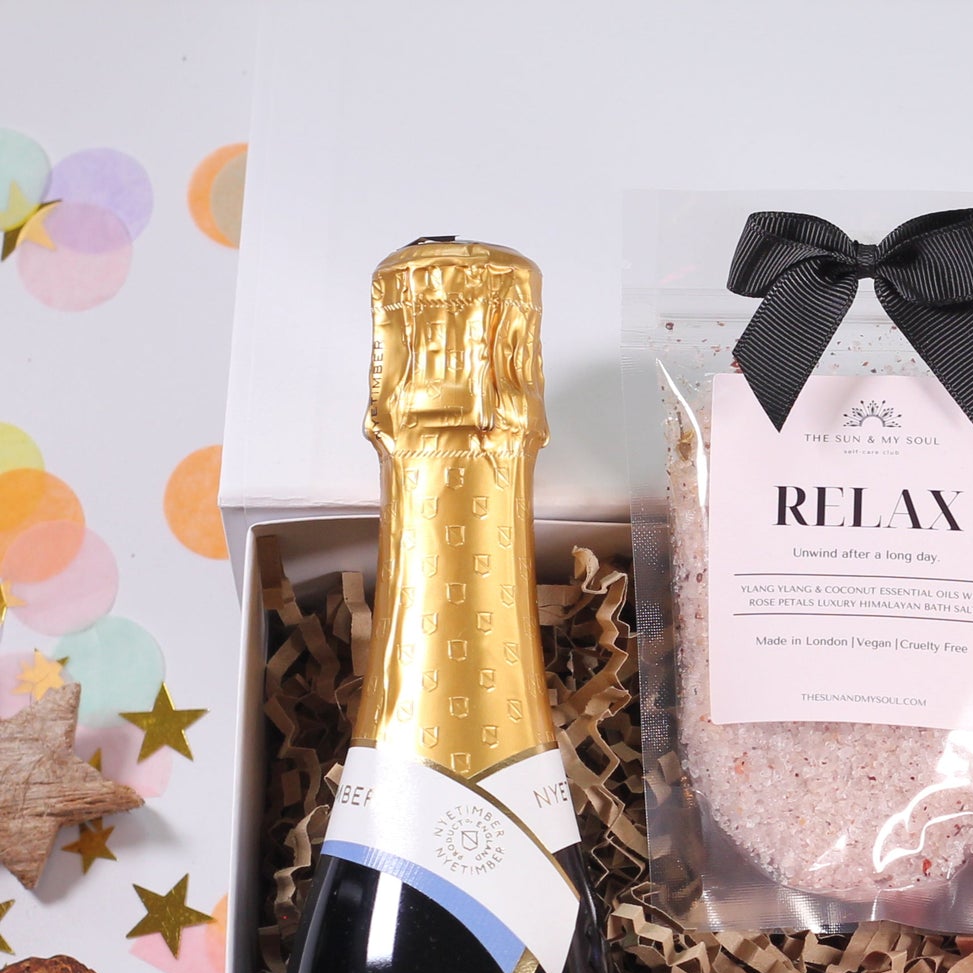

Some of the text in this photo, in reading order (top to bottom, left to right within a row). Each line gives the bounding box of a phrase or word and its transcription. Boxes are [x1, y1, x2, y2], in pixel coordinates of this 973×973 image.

[804, 433, 939, 446] THE SUN & MY SOUL
[773, 484, 964, 532] RELAX
[792, 547, 941, 565] Unwind after a long day.
[741, 584, 775, 594] YLANG
[778, 584, 812, 594] YLANG
[814, 585, 822, 594] &
[824, 585, 877, 596] COCONUT
[879, 587, 933, 598] ESSENTIAL
[936, 590, 960, 600] OILS
[749, 598, 776, 607] ROSE
[778, 598, 815, 607] PETALS
[817, 599, 856, 608] LUXURY
[859, 600, 921, 611] HIMALAYAN
[924, 603, 951, 613] BATH
[755, 635, 788, 647] Made
[791, 635, 802, 647] in
[805, 635, 848, 648] London
[944, 641, 969, 654] Free
[801, 692, 927, 706] THESUNANDMYSOUL.COM
[433, 806, 505, 837] NYETIMBER
[435, 846, 505, 875] NYETIMBER
